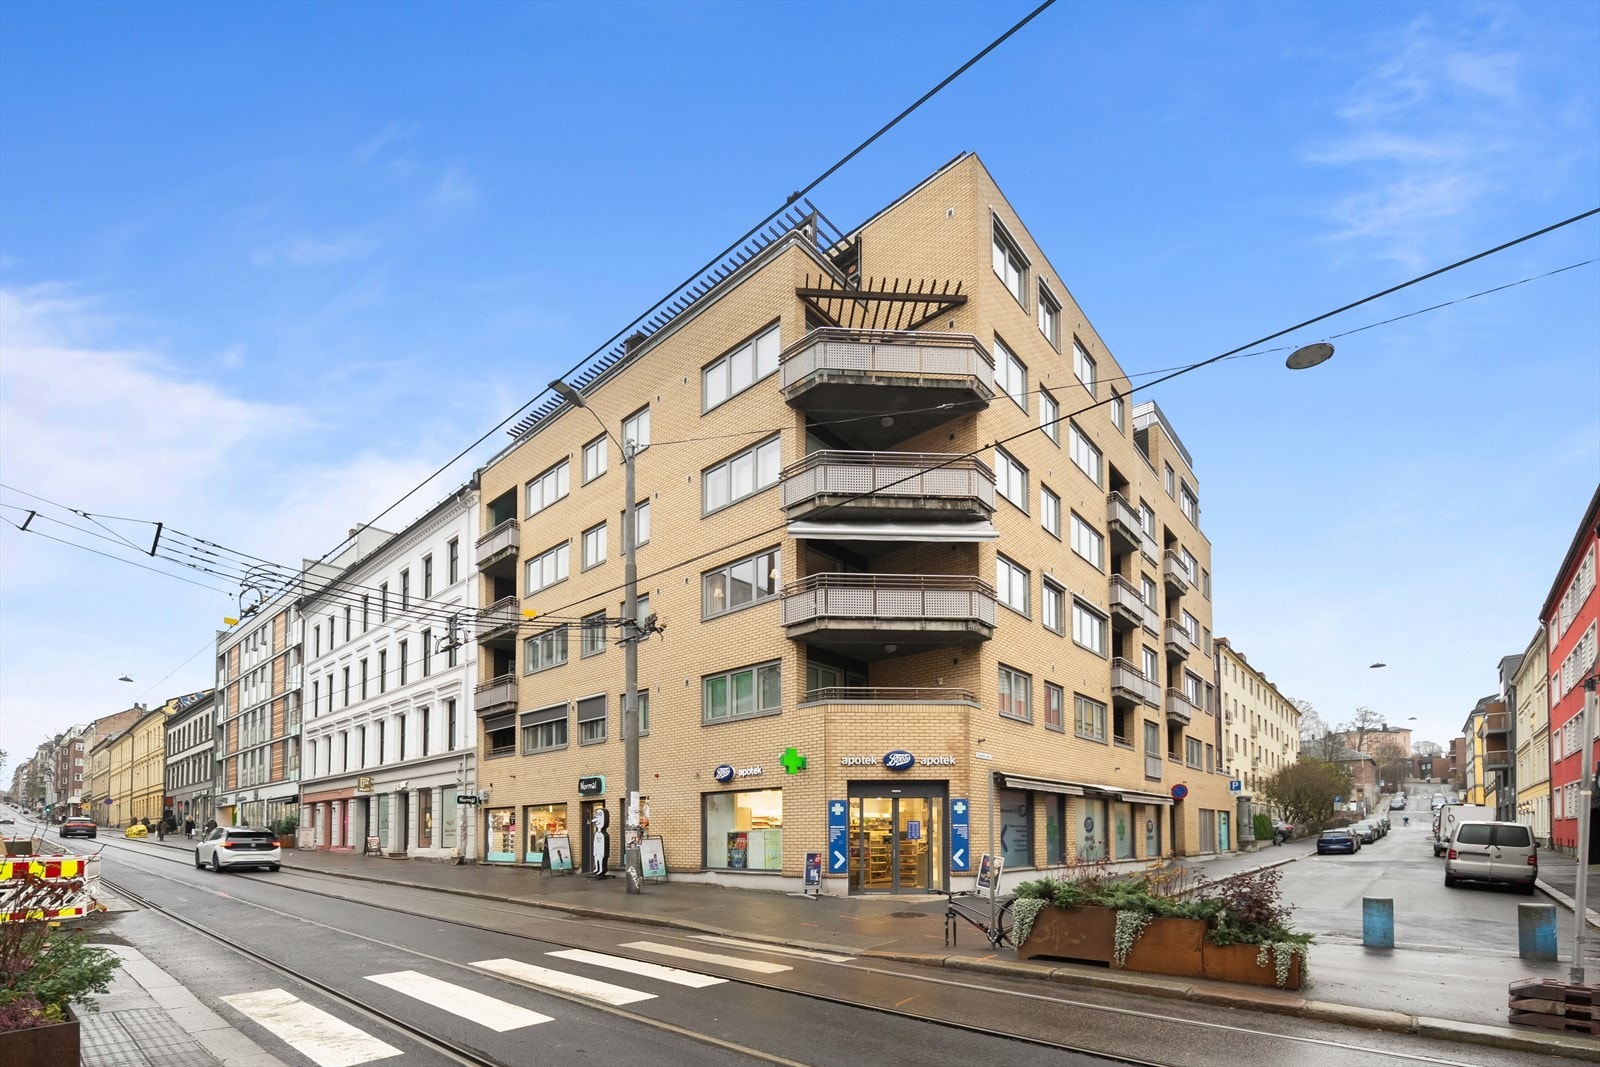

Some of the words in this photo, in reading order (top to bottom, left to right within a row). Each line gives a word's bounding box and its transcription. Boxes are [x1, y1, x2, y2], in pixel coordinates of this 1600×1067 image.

[841, 755, 877, 766] apotek
[920, 755, 956, 766] apotek
[738, 766, 762, 777] apotek
[1232, 781, 1239, 790] P
